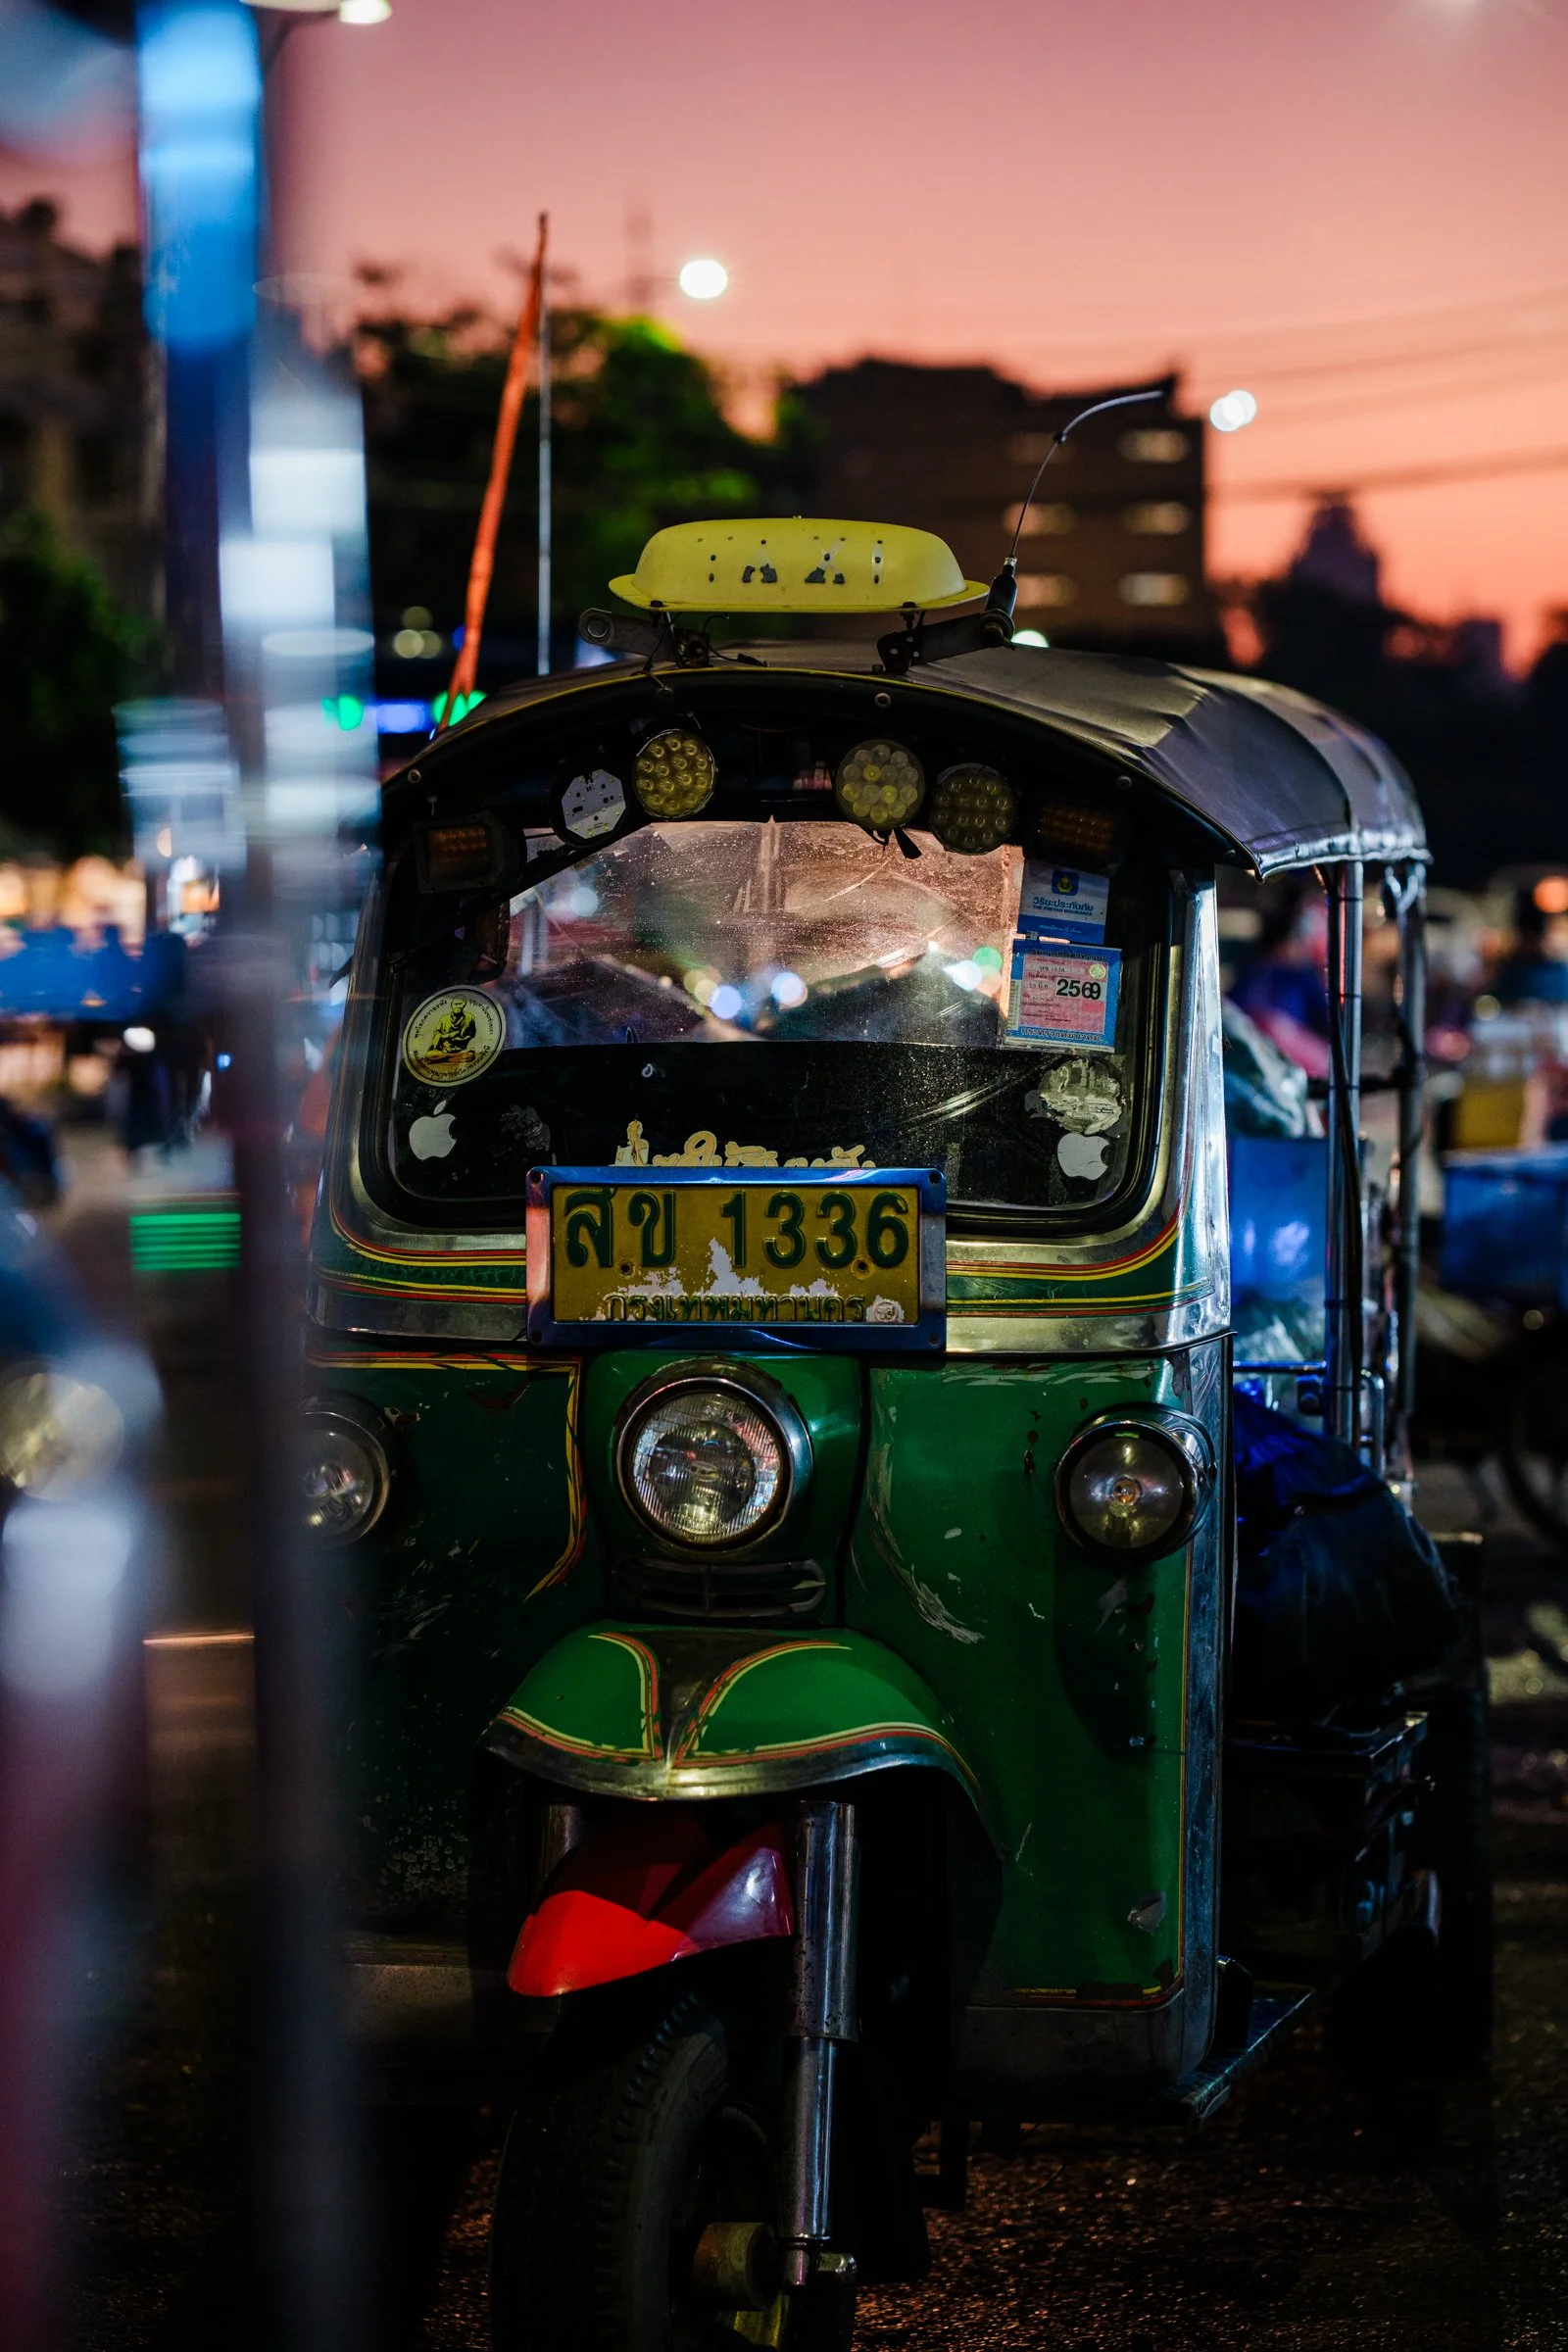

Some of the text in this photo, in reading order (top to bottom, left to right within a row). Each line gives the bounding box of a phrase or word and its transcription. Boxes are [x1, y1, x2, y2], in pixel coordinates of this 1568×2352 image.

[1055, 978, 1102, 1001] 2569
[721, 1190, 909, 1268] 1336
[603, 1293, 865, 1322] กรงเทพมหานคร
